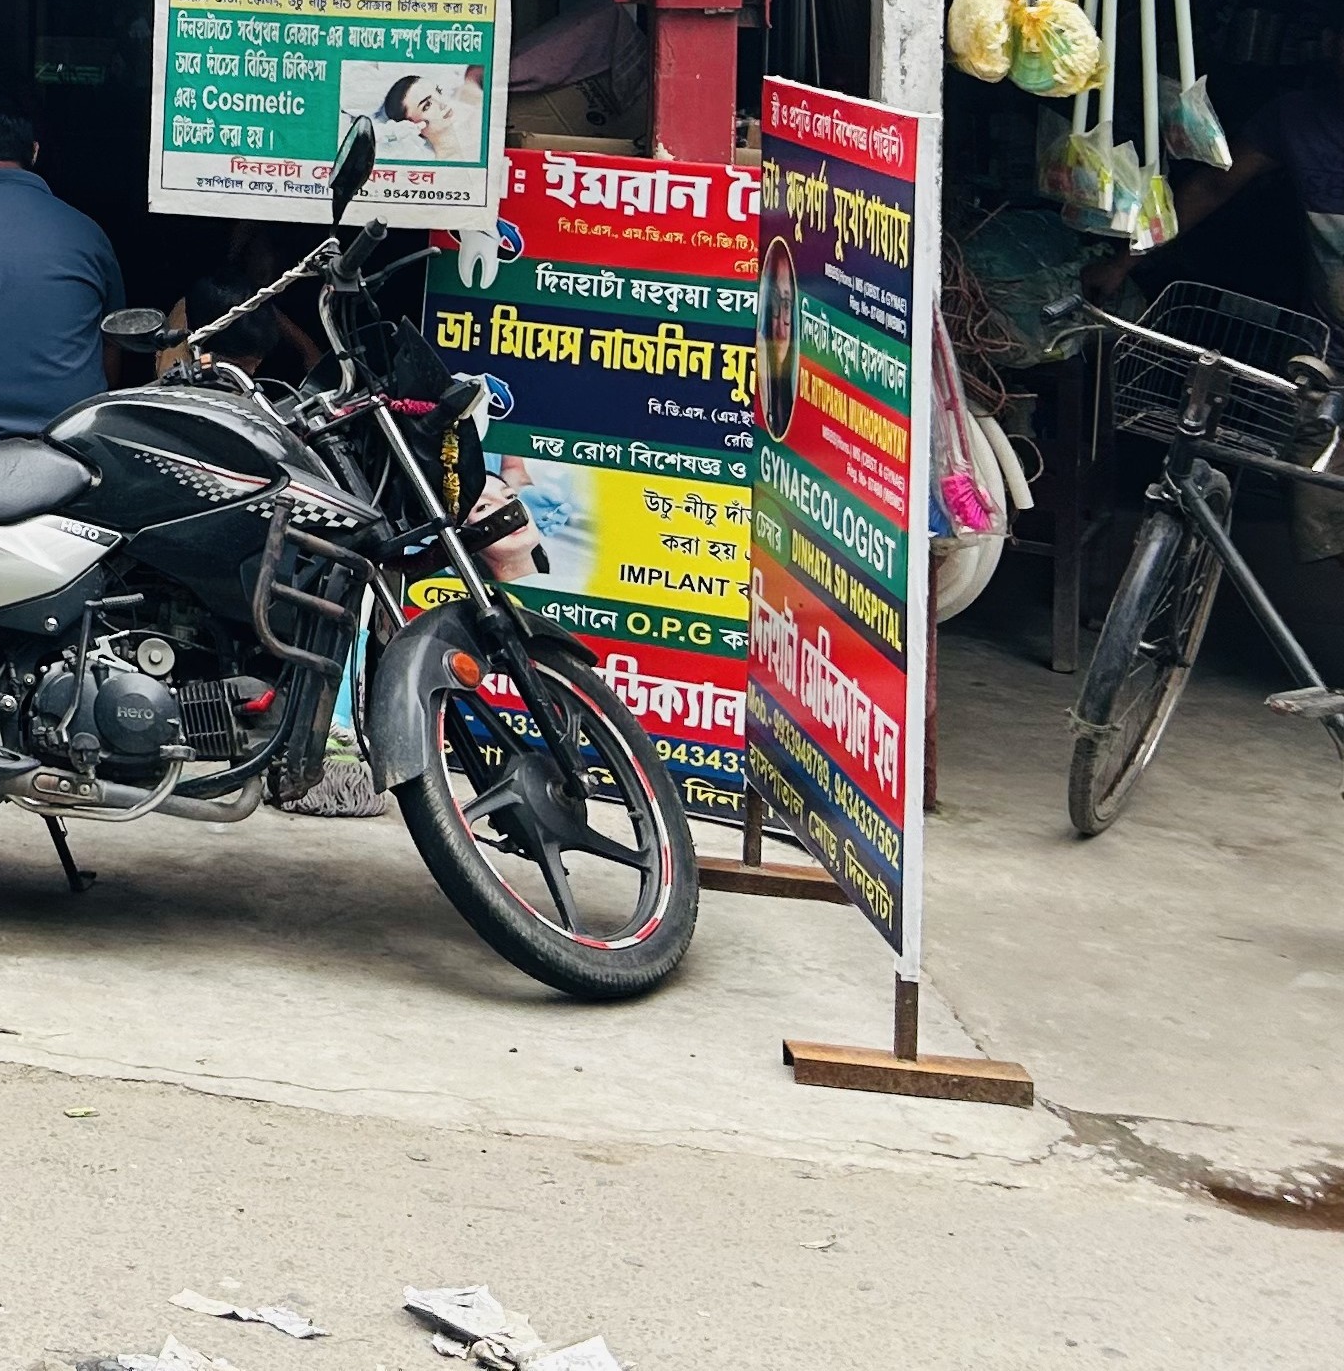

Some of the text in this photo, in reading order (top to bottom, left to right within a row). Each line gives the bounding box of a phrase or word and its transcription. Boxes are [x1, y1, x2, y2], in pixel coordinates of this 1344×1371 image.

[203, 85, 305, 116] Cosmetic
[543, 150, 712, 218] ইমরান
[490, 303, 714, 381] মিসেস নাজনিন
[572, 440, 624, 463] রোগ
[61, 520, 99, 540] Hero
[761, 445, 896, 580] GYNAECOLOGIST
[620, 564, 730, 598] IMPLANT
[791, 529, 902, 653] DINHATA SD HOSPITAL
[541, 601, 712, 646] এখানে O.P.G
[117, 706, 154, 719] Hero
